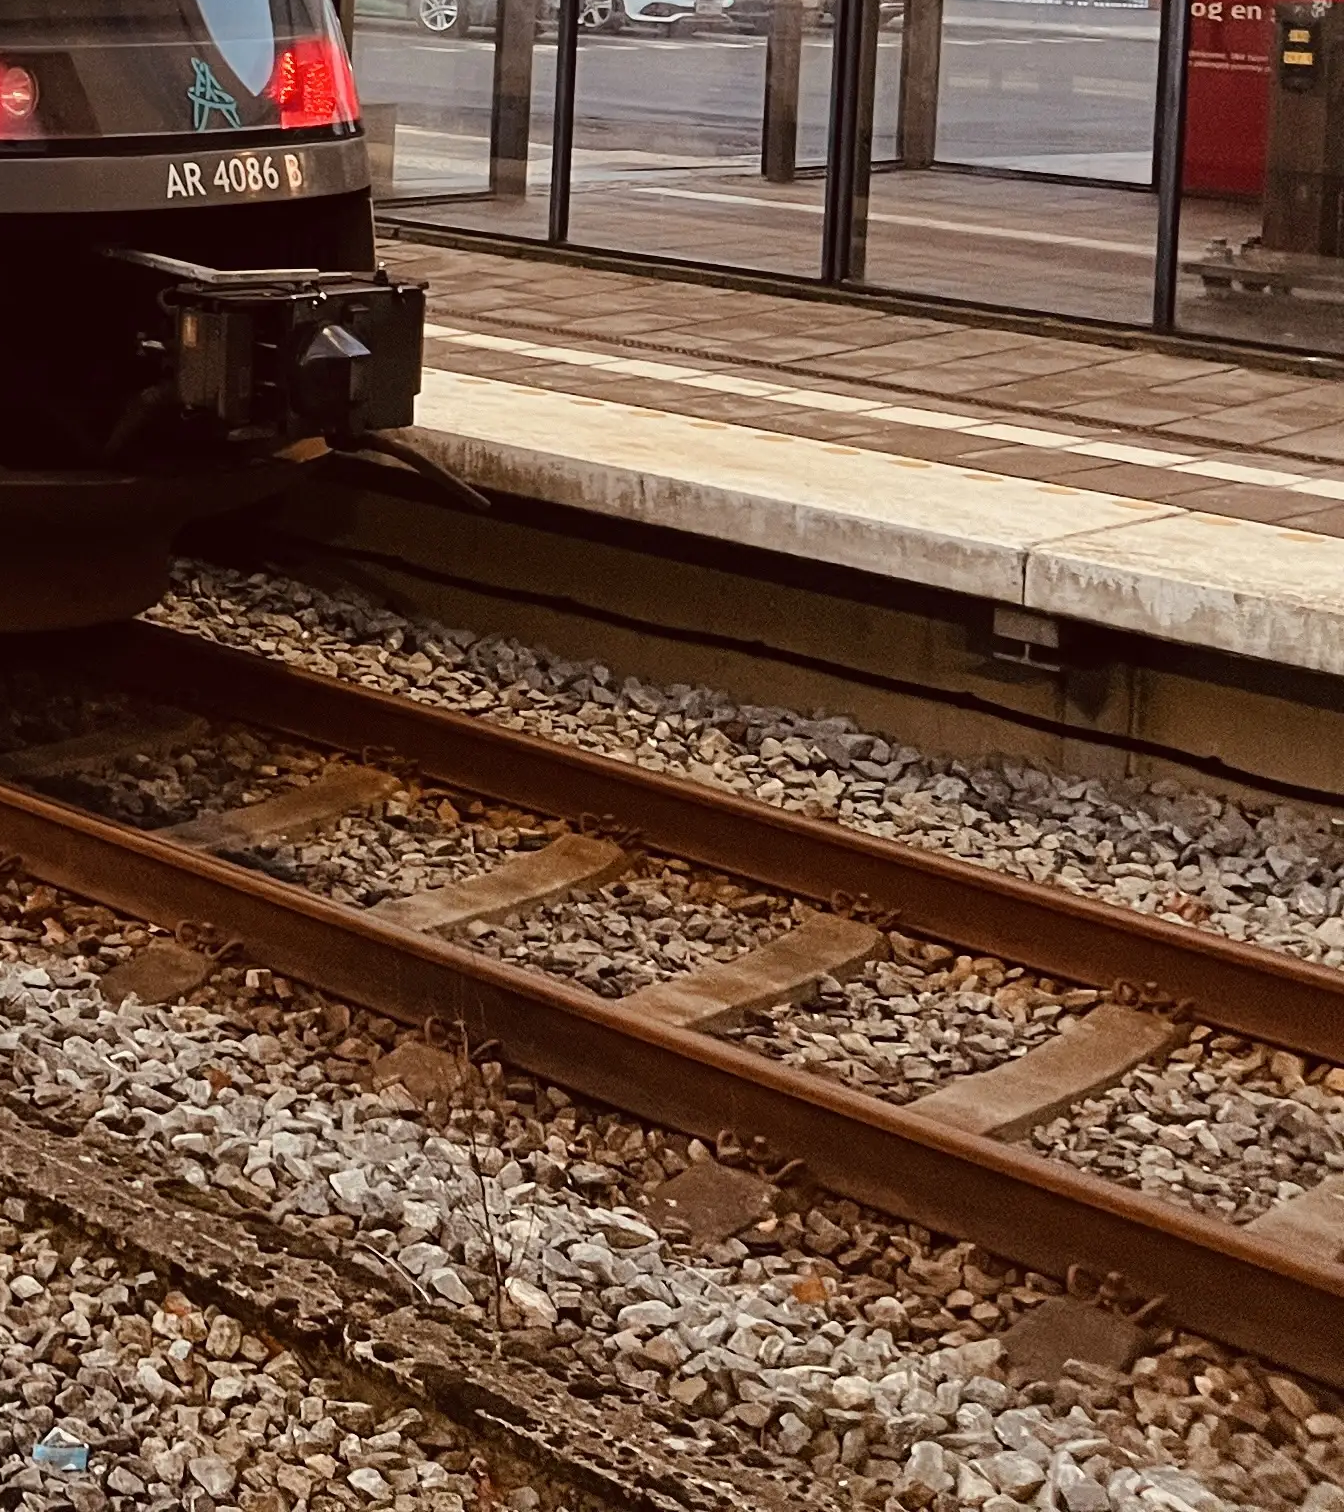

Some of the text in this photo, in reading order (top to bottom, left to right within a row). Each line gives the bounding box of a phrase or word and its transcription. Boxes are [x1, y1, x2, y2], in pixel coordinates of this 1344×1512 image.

[1190, 1, 1223, 22] og
[1230, 4, 1262, 20] en
[167, 153, 303, 199] AR 4086 B
